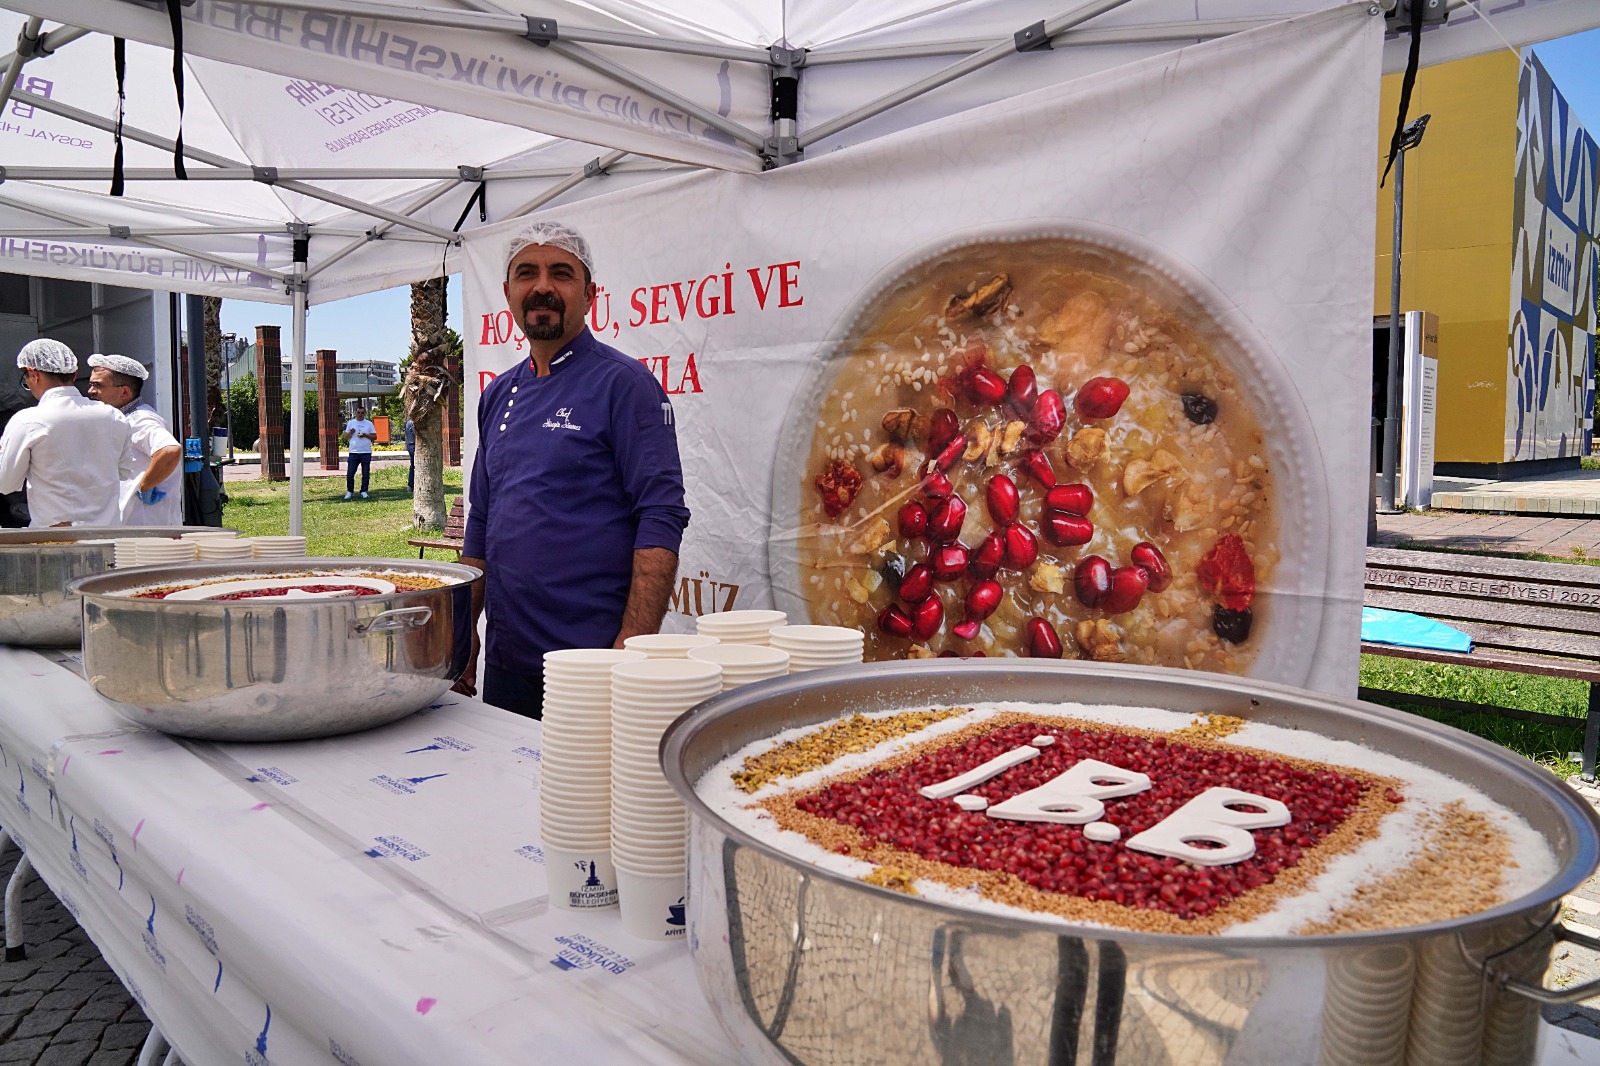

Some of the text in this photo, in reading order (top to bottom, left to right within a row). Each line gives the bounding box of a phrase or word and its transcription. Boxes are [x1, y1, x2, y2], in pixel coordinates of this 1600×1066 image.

[629, 262, 735, 328] SEVGİ
[747, 260, 804, 311] VE
[1458, 580, 1556, 600] BELEDİYESİ
[1560, 590, 1600, 605] 2022
